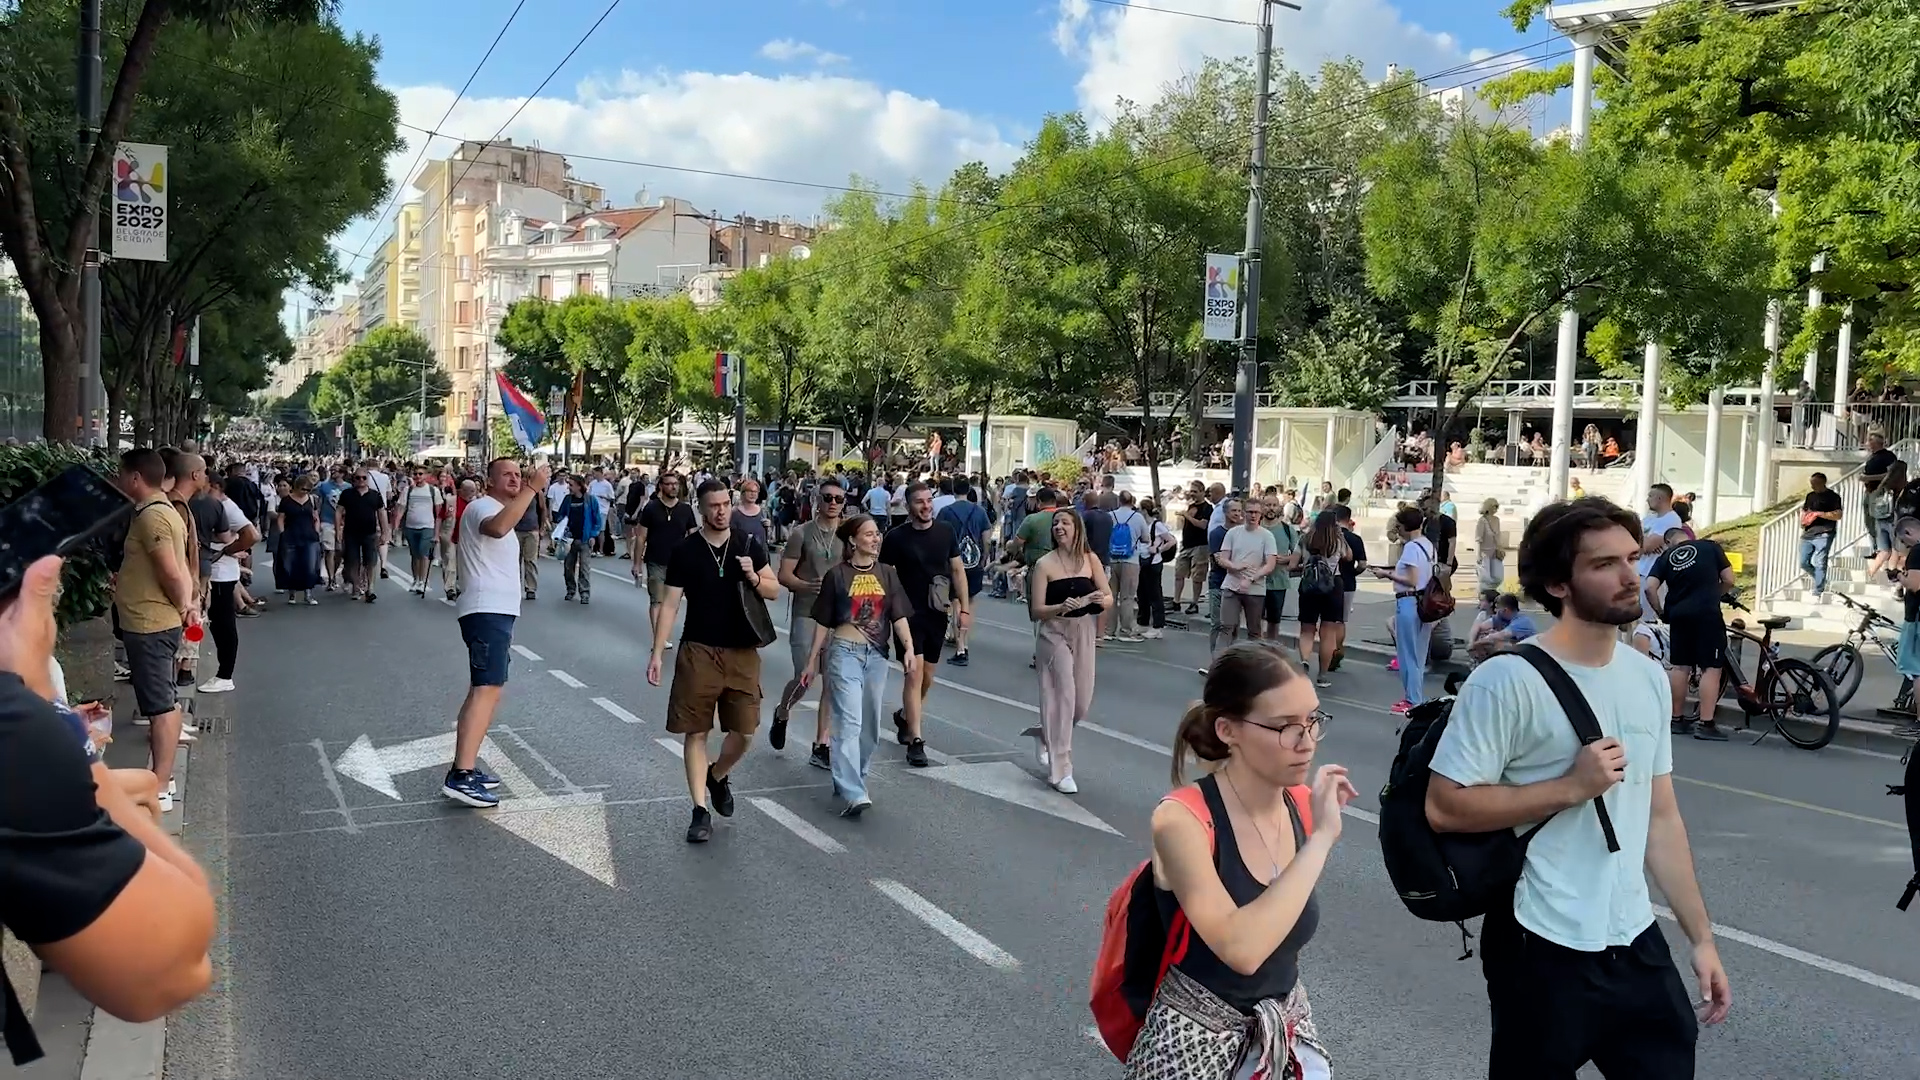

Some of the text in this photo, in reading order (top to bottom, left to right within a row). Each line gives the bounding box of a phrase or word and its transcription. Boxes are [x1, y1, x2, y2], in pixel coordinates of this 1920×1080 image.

[117, 203, 164, 217] EXPO
[117, 215, 164, 229] 2027
[116, 227, 164, 238] BELGRADE
[116, 234, 152, 243] SERBIA
[1207, 299, 1235, 309] EXPO
[1207, 307, 1235, 318] 2027
[852, 574, 879, 585] STAR
[848, 583, 886, 597] WARS
